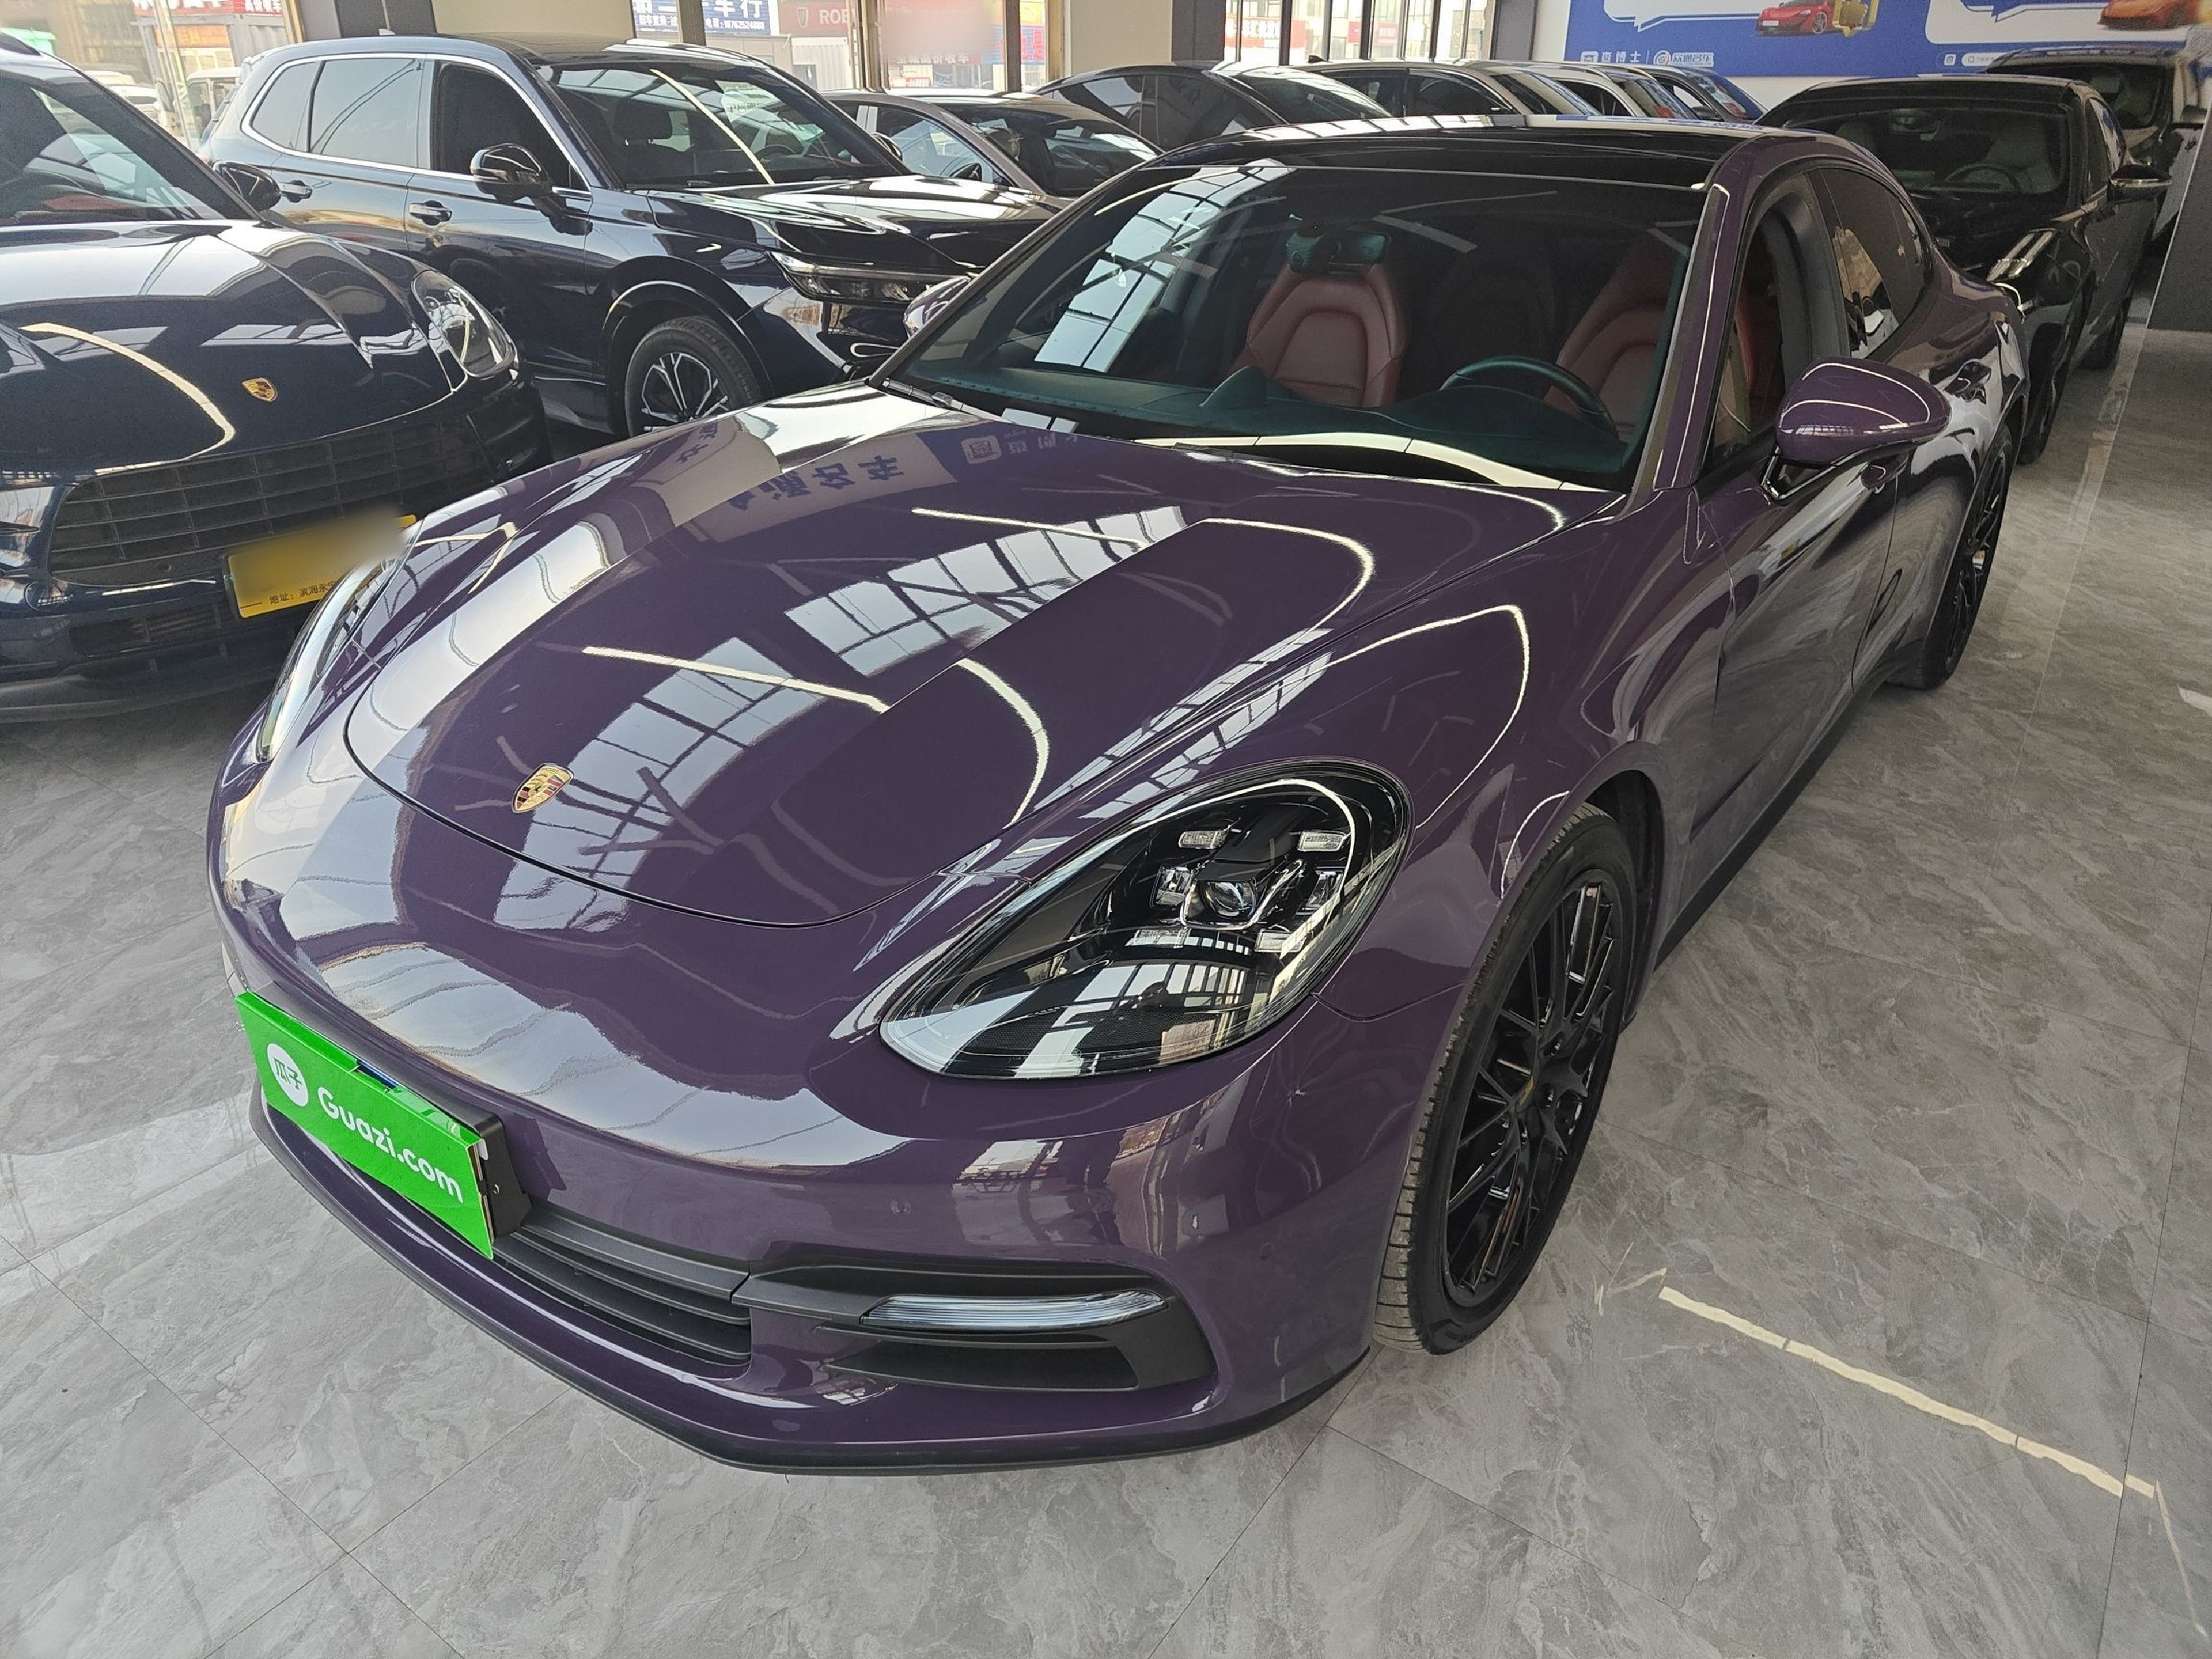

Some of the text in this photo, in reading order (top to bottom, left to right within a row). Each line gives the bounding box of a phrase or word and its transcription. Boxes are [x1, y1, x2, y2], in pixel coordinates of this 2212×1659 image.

[1601, 51, 1641, 63] 查博士
[274, 1057, 302, 1090] 瓜子
[317, 1087, 463, 1203] Guazi.com
